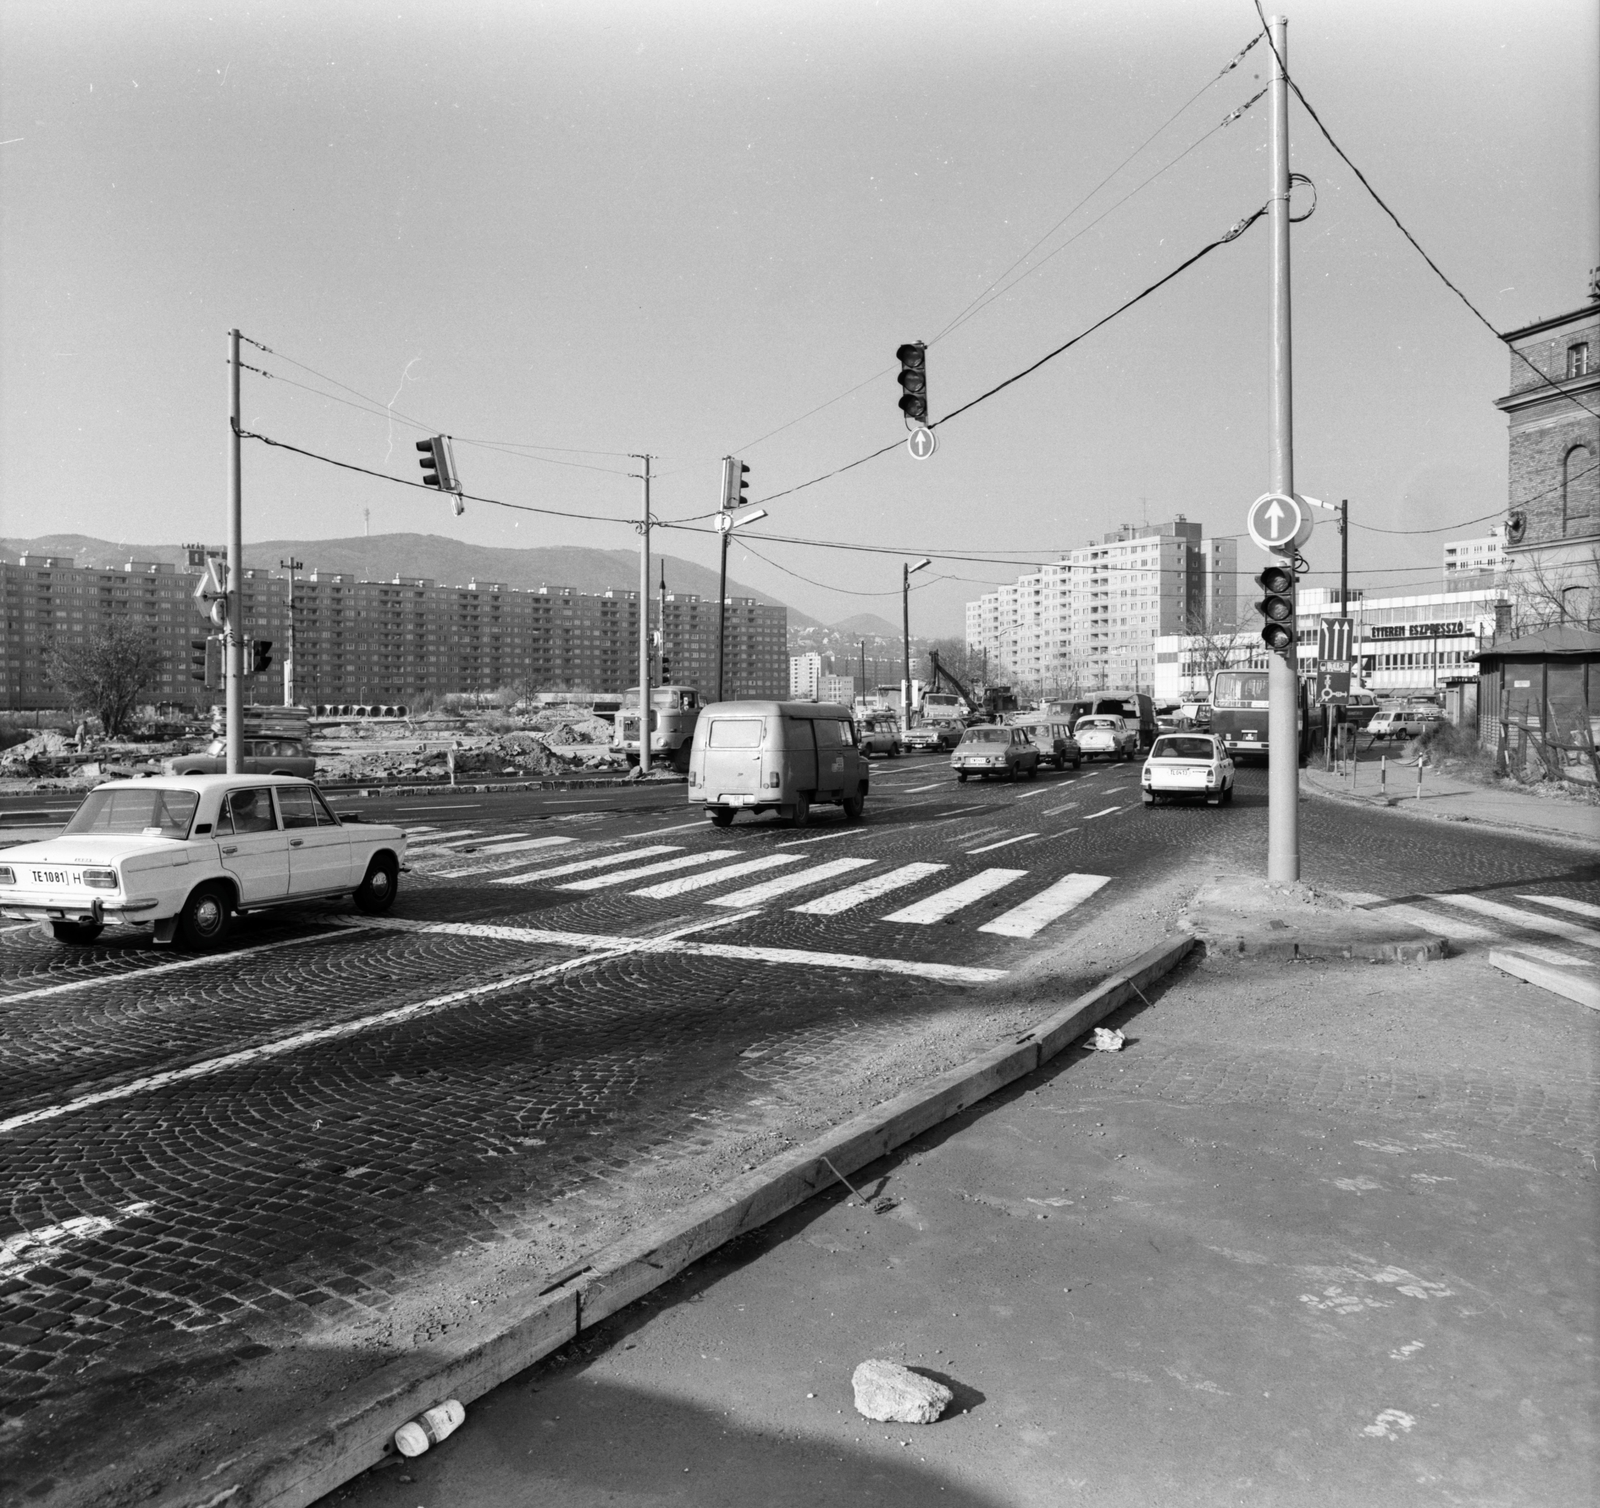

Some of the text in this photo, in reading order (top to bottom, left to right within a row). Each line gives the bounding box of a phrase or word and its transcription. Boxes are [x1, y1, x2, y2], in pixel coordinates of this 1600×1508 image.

[182, 542, 205, 550] LAKÁS
[1371, 626, 1405, 638] ÉTTEREM
[32, 871, 81, 884] TE1081 H
